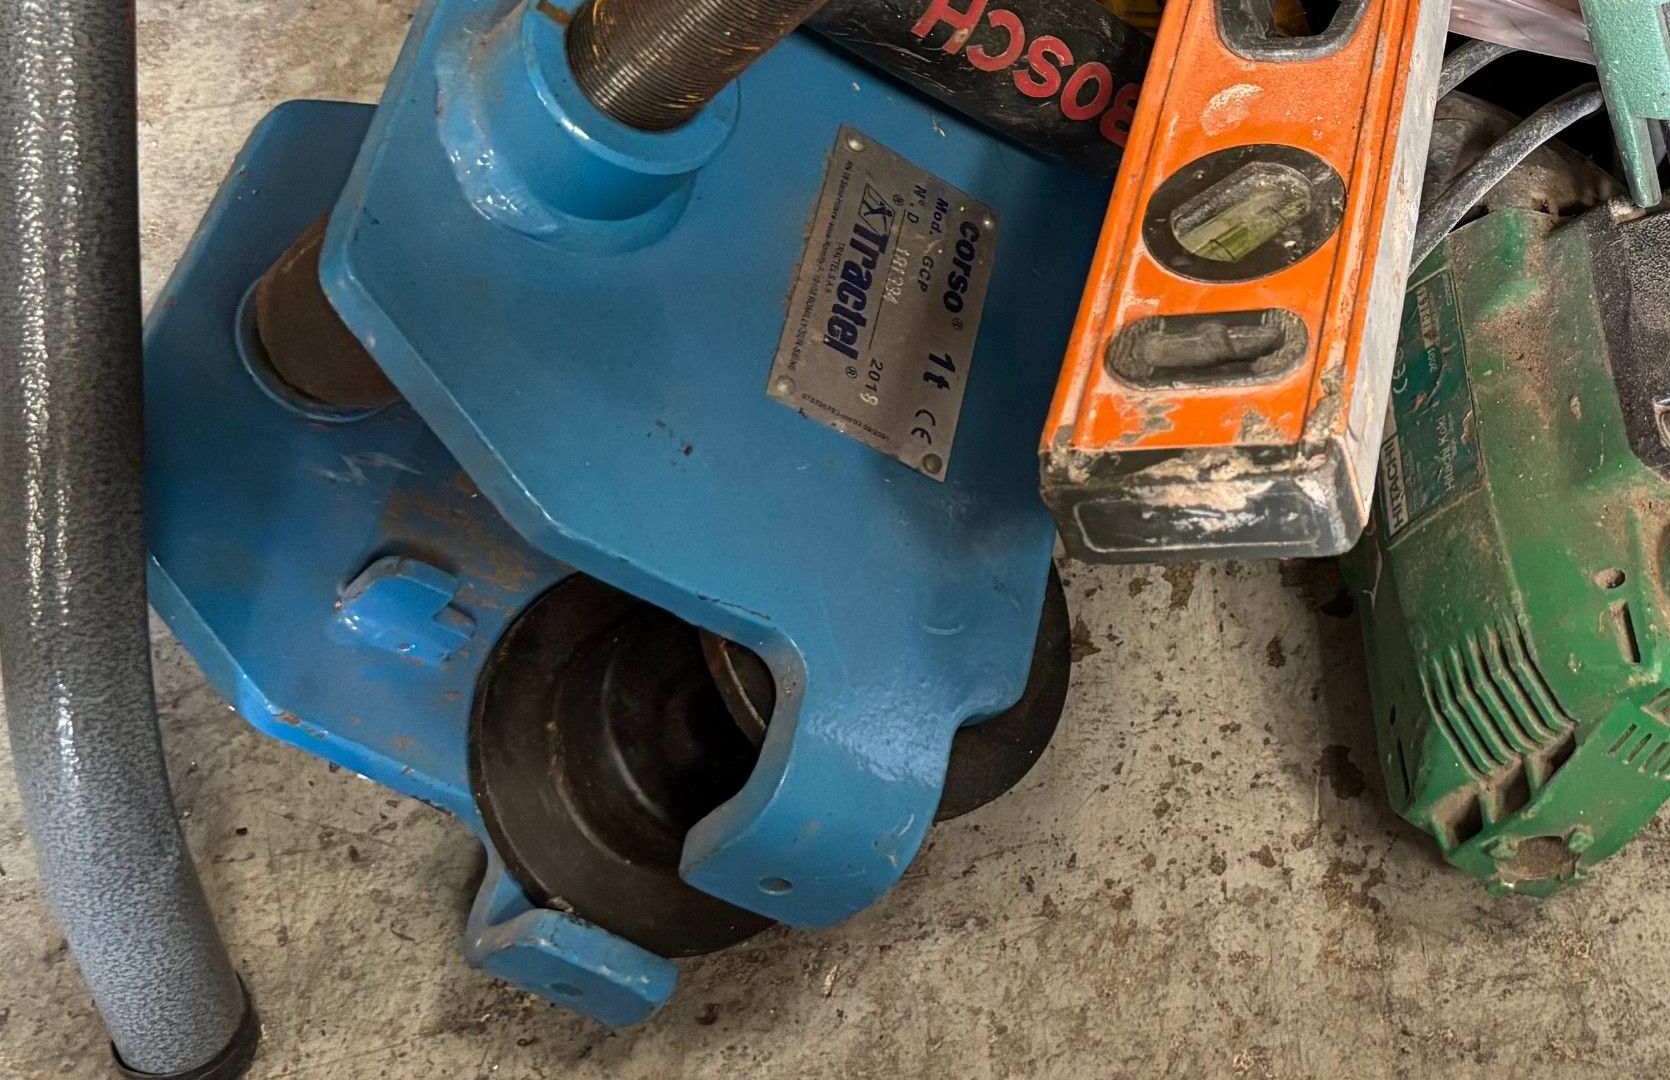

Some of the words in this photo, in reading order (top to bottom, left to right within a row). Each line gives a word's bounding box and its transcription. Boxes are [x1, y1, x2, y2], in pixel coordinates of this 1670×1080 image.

[929, 197, 949, 235] Mod.
[823, 223, 889, 360] Tractel
[917, 255, 934, 293] GCP
[943, 221, 980, 314] corso
[922, 352, 956, 390] 1t
[1384, 440, 1405, 530] HITACHI
